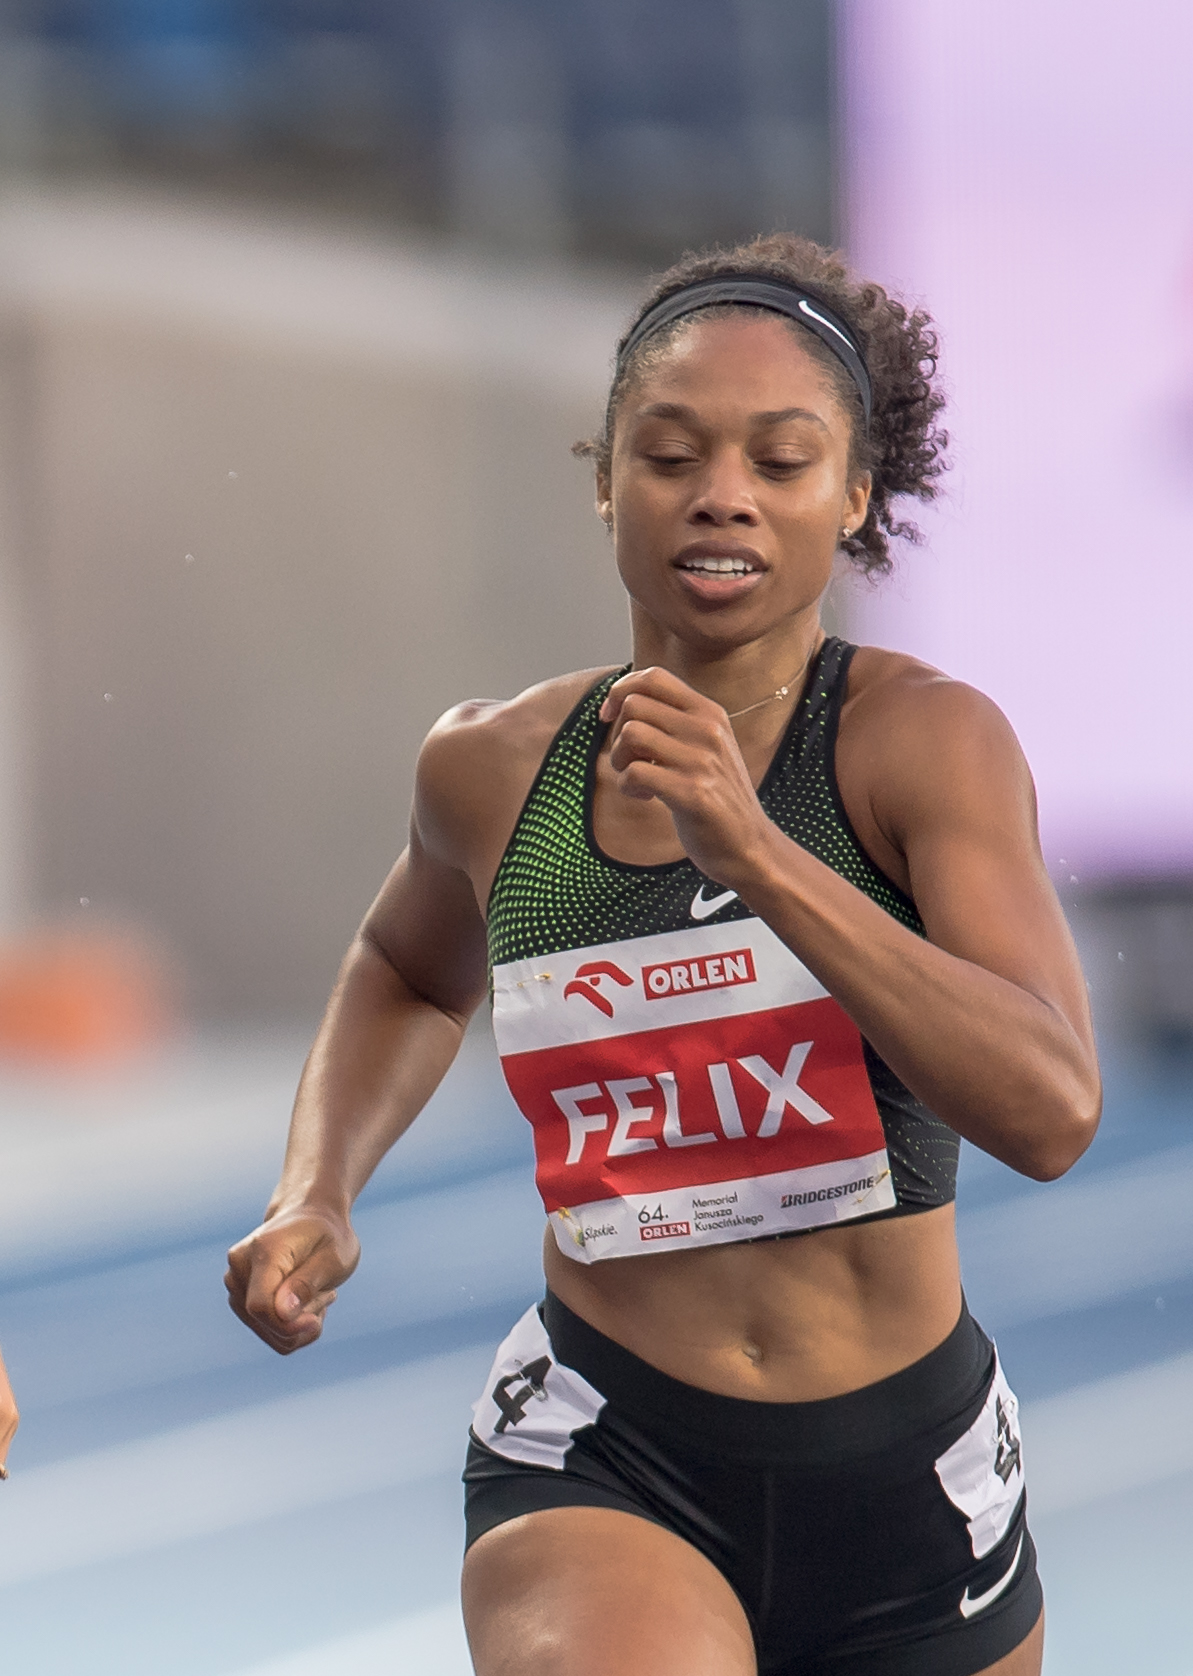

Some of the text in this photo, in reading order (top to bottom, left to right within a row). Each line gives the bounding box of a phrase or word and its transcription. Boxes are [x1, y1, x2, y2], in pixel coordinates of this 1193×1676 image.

[647, 953, 749, 994] ORLEN
[550, 1040, 835, 1166] FELIX
[780, 1176, 875, 1208] BRIDGESTONE
[637, 1203, 669, 1224] 64.
[693, 1208, 733, 1220] Janusza
[642, 1223, 689, 1239] ORLEN
